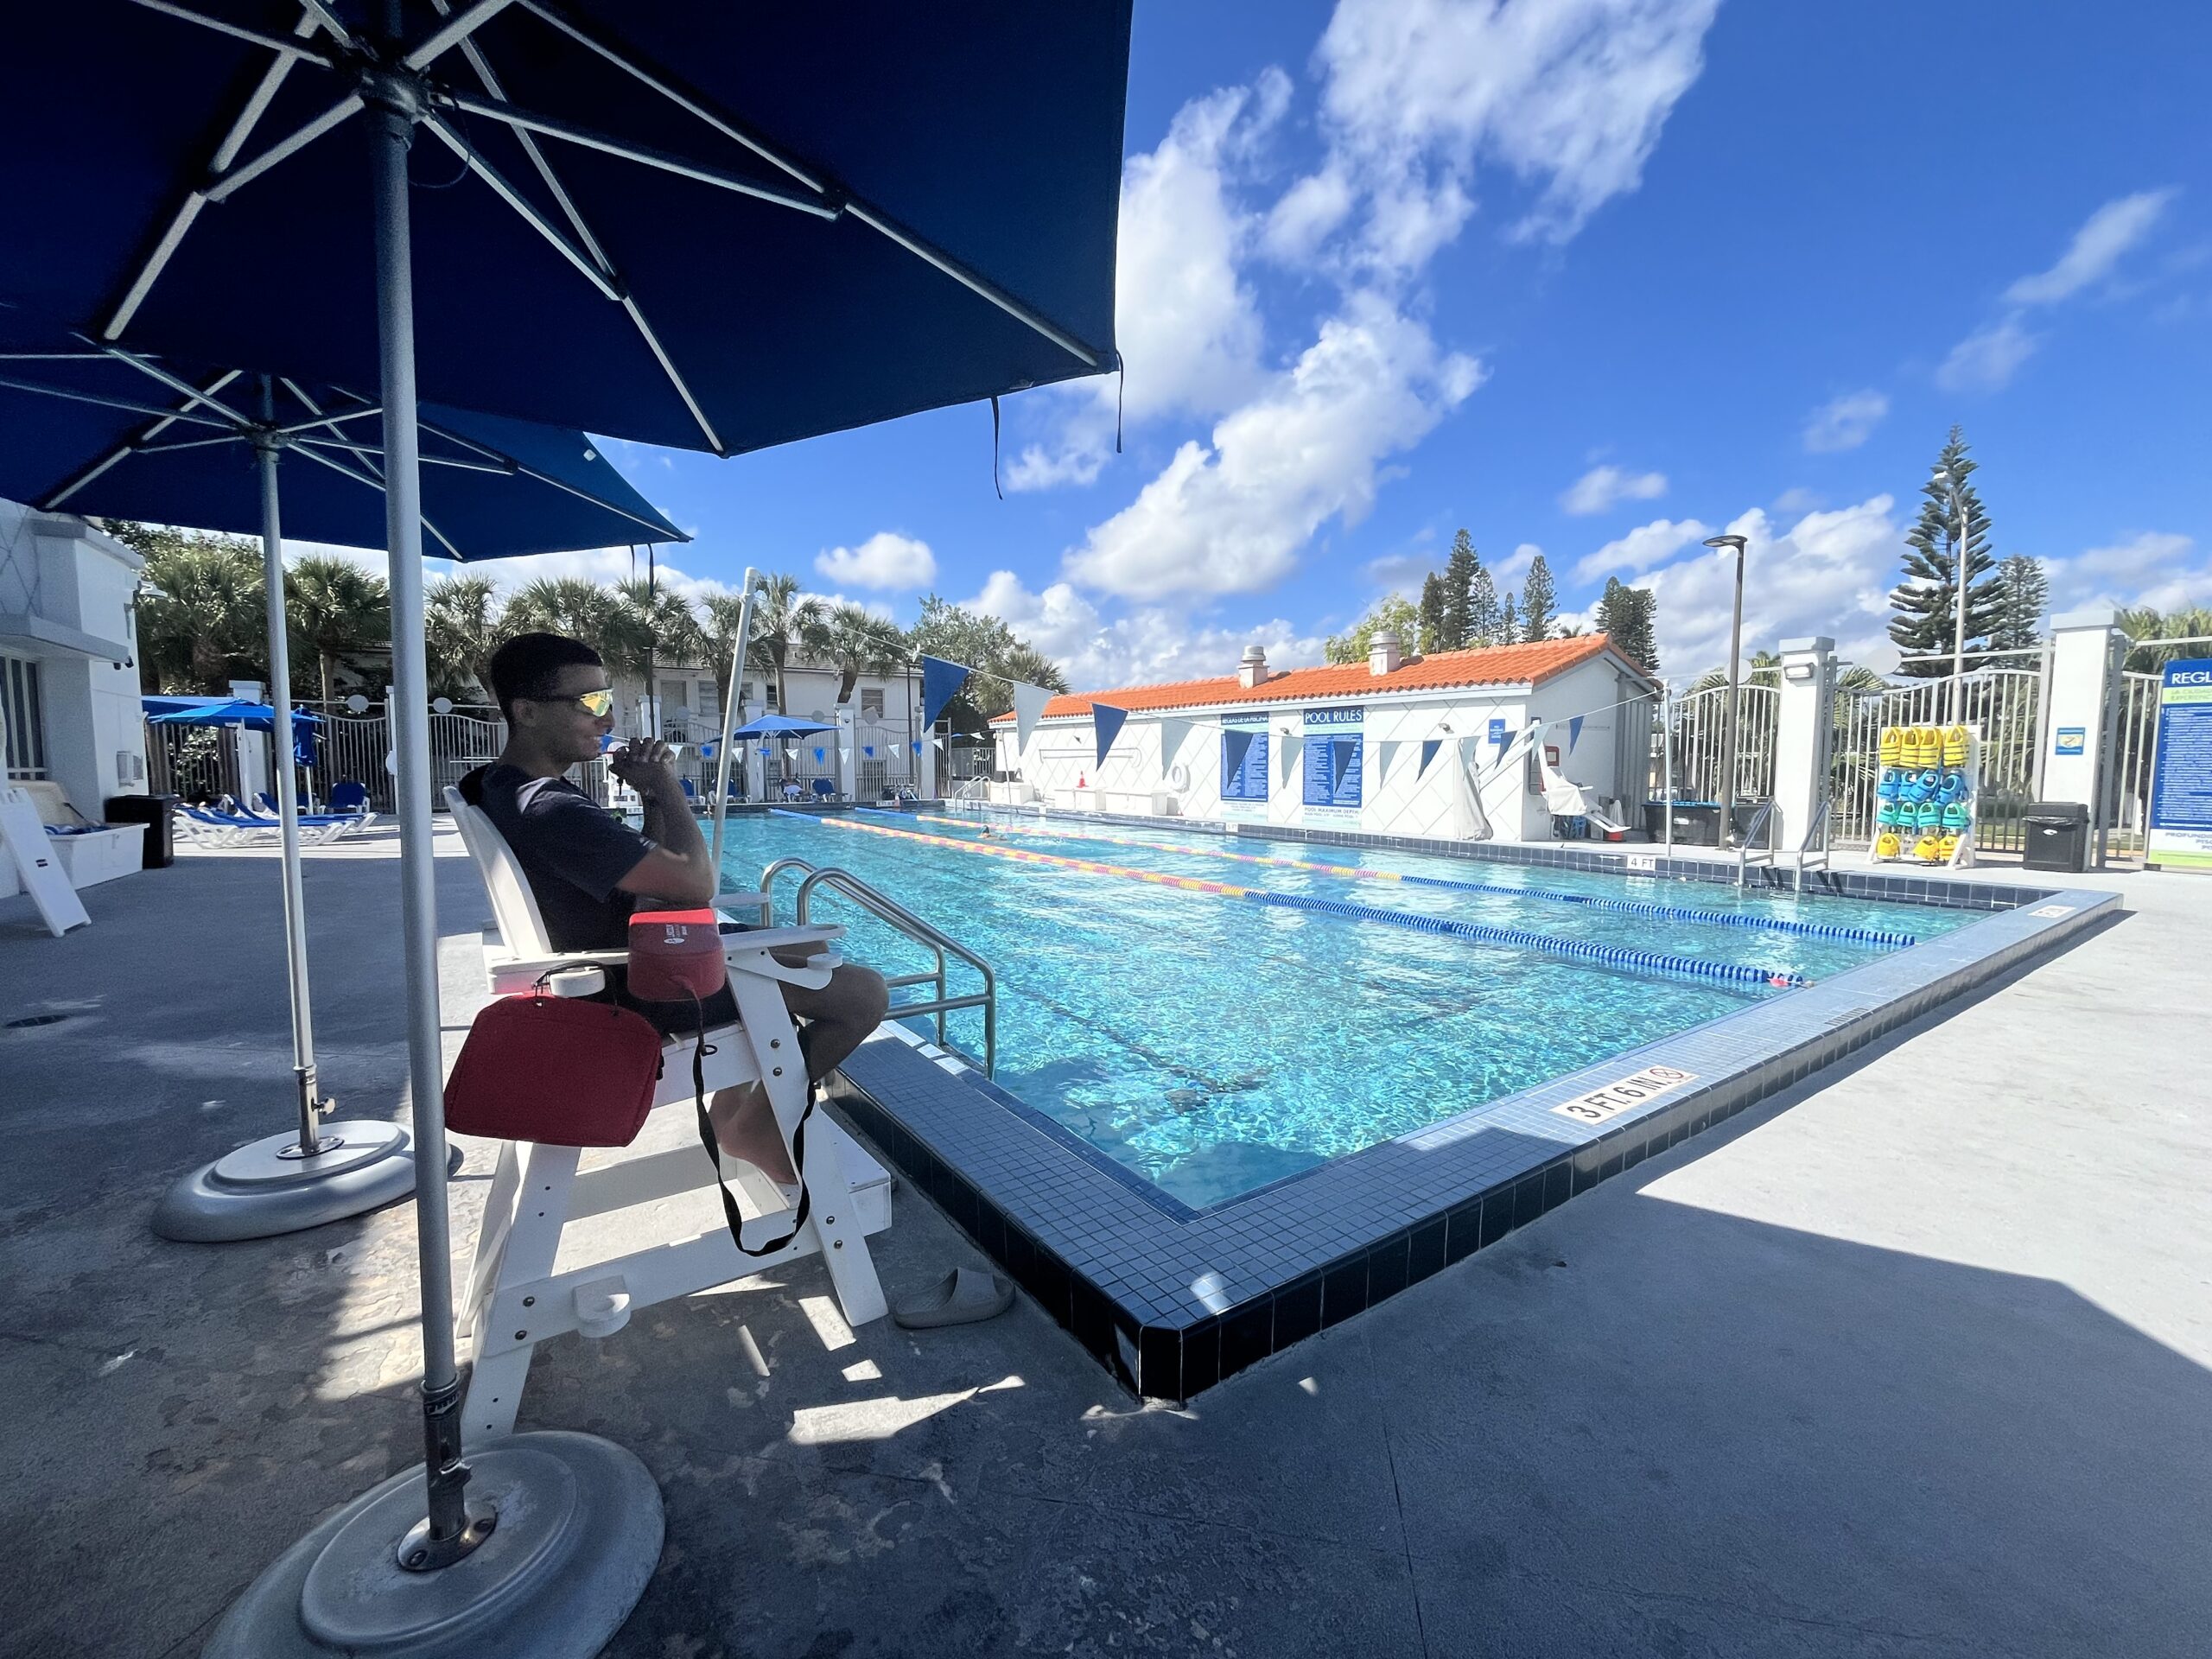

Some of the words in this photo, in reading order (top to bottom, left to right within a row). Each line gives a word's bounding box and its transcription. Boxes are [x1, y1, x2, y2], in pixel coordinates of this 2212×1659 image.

[1306, 712, 1331, 723] POOL
[1333, 709, 1363, 722] RULES
[1631, 858, 1637, 867] 4
[1642, 859, 1654, 868] FT
[1567, 1105, 1601, 1118] 3
[1613, 1086, 1646, 1097] 6
